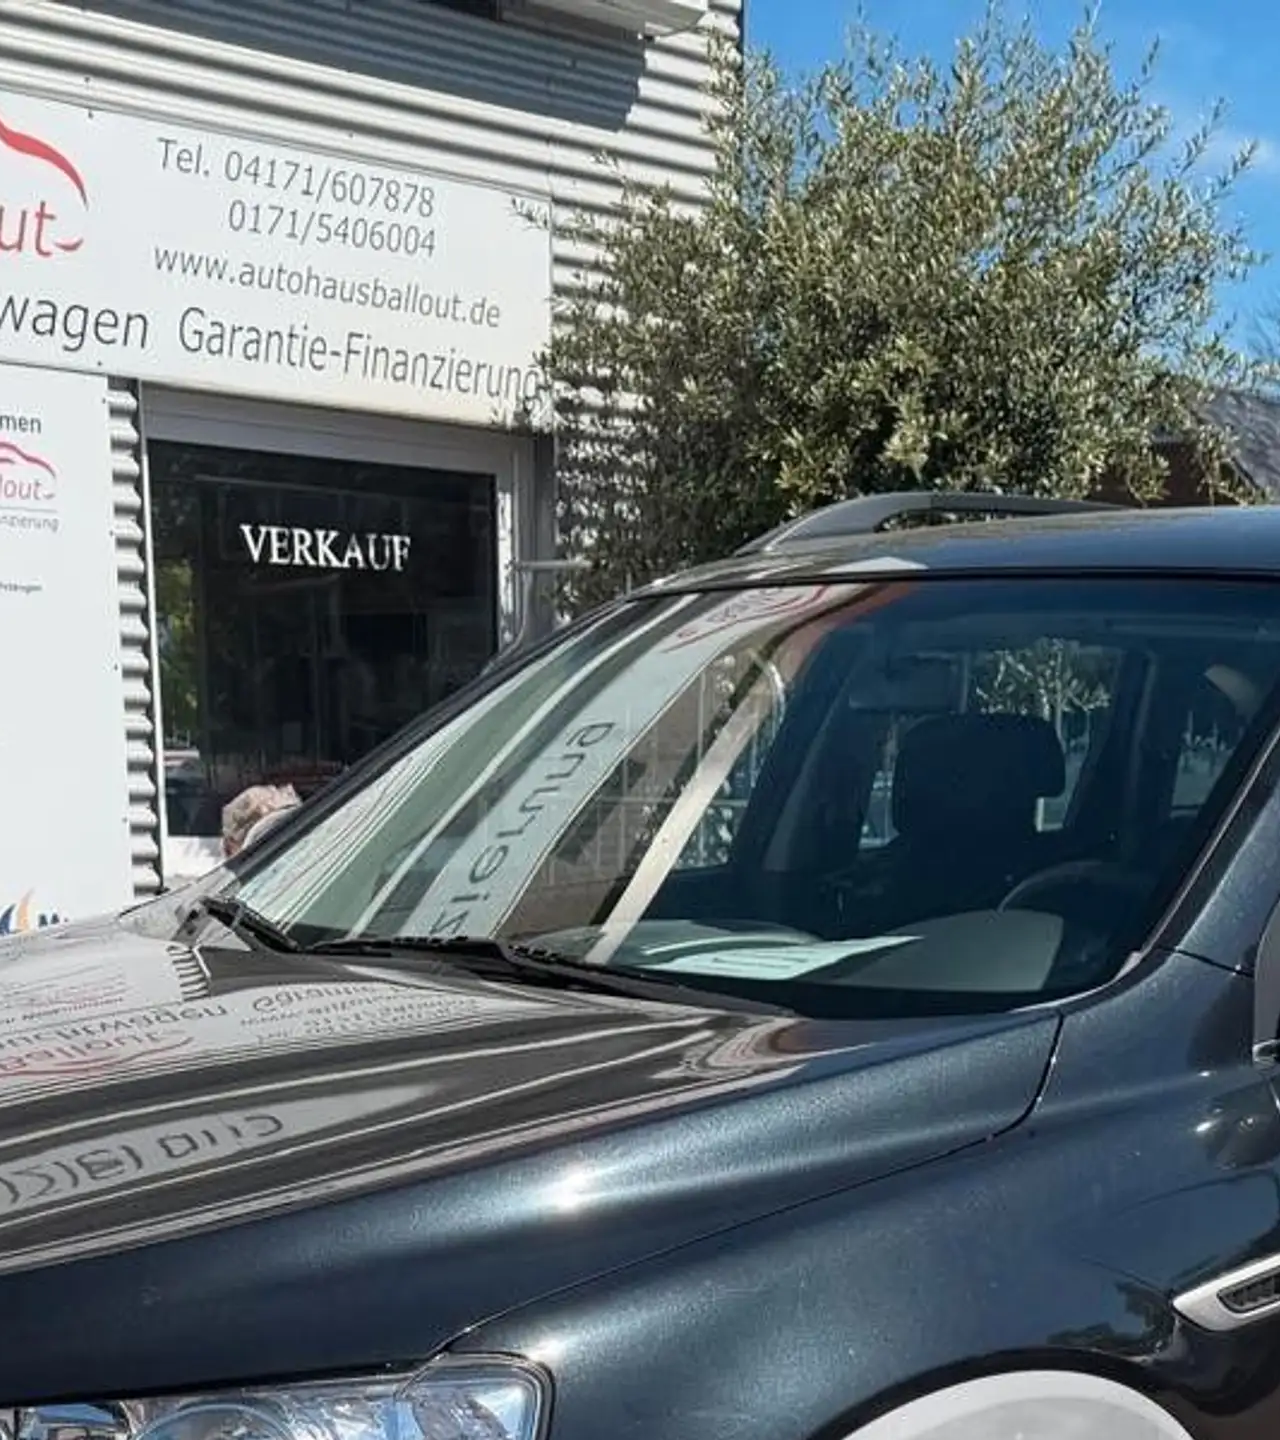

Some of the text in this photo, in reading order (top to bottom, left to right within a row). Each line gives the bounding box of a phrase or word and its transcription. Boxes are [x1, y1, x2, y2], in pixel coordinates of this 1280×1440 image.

[157, 137, 437, 219] Tel. 04171/607878
[227, 199, 437, 258] 0171/5406004
[153, 245, 502, 329] www.autohausballout.de
[177, 306, 544, 415] Garantie-Finanzierung
[240, 523, 411, 572] VERKAUF
